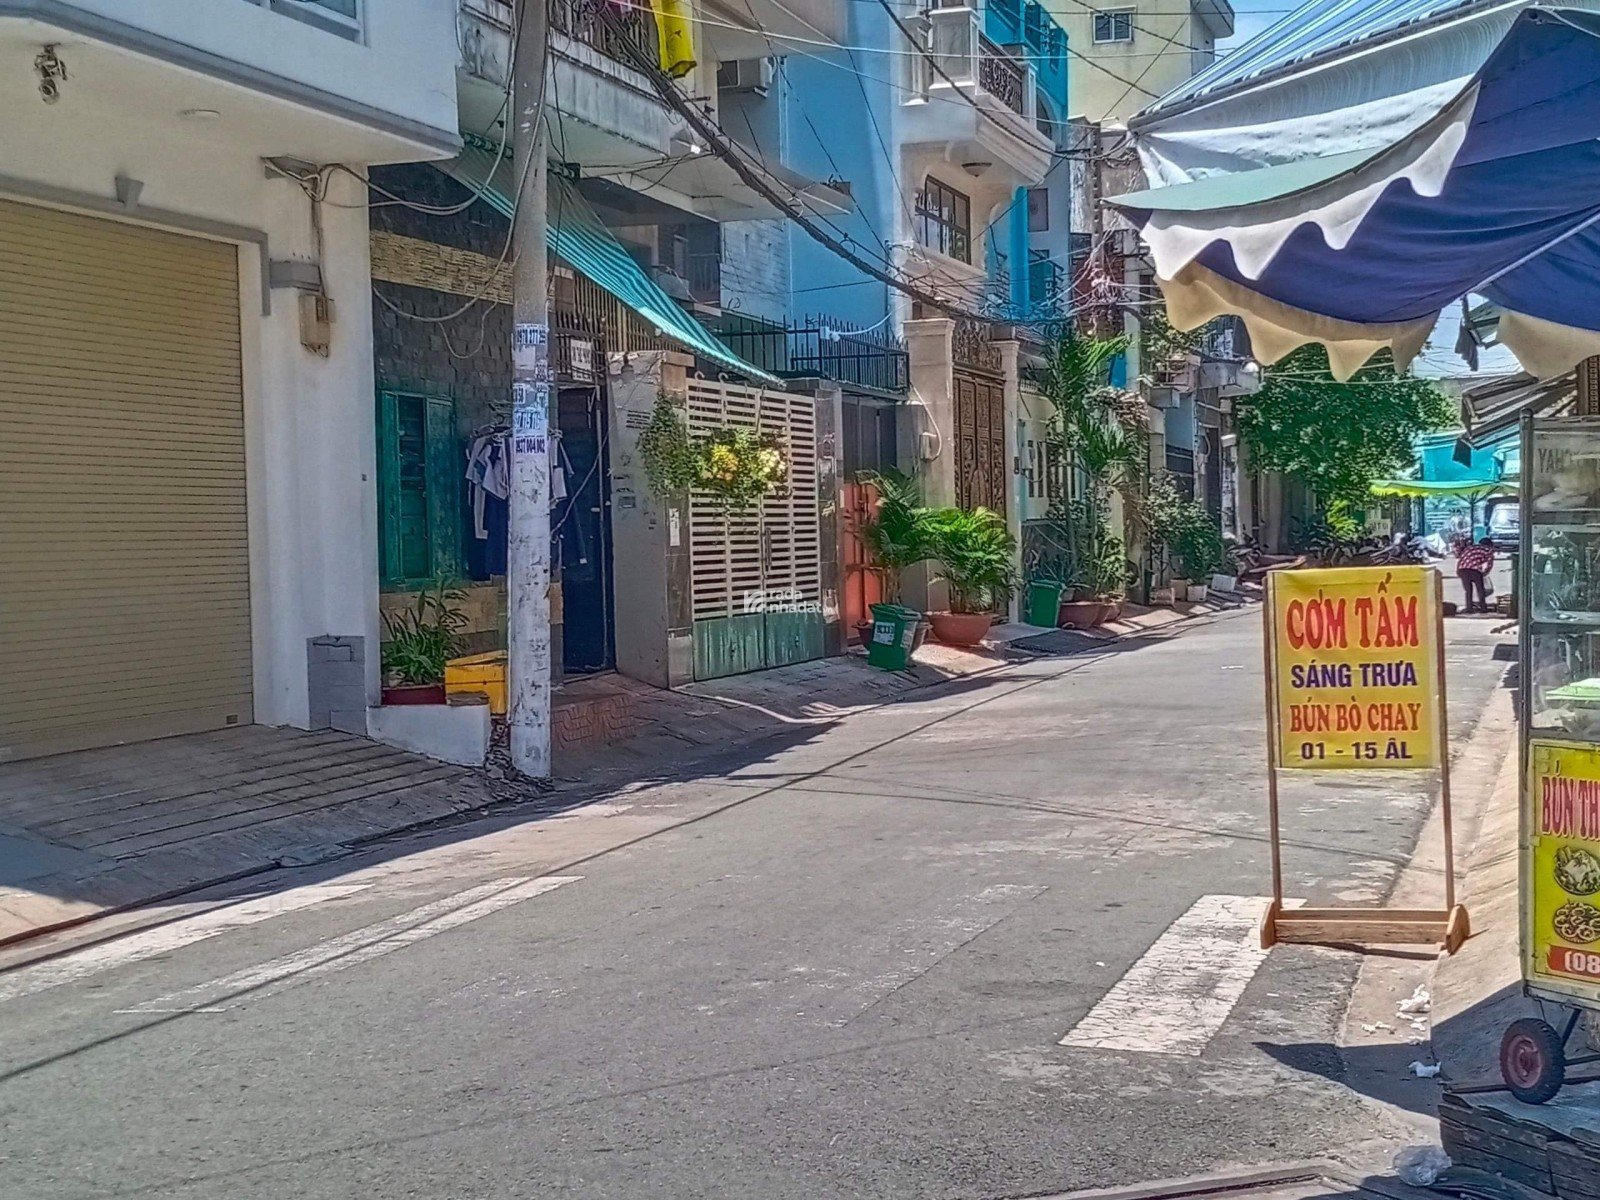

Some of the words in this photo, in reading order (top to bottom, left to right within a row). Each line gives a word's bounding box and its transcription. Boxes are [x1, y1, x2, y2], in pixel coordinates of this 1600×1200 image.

[1286, 589, 1348, 649] CƠM
[1354, 572, 1419, 648] TẤM
[1291, 659, 1352, 688] SÁNG
[1359, 660, 1418, 687] TRƯA
[1290, 697, 1330, 732] BÚN
[1336, 696, 1362, 732] BÒ
[1367, 703, 1421, 731] CHAY
[1301, 742, 1325, 760] 01
[1352, 742, 1377, 760] 15
[1385, 738, 1413, 759] ÂL
[1541, 760, 1574, 838] BÚN
[1579, 779, 1600, 840] TH
